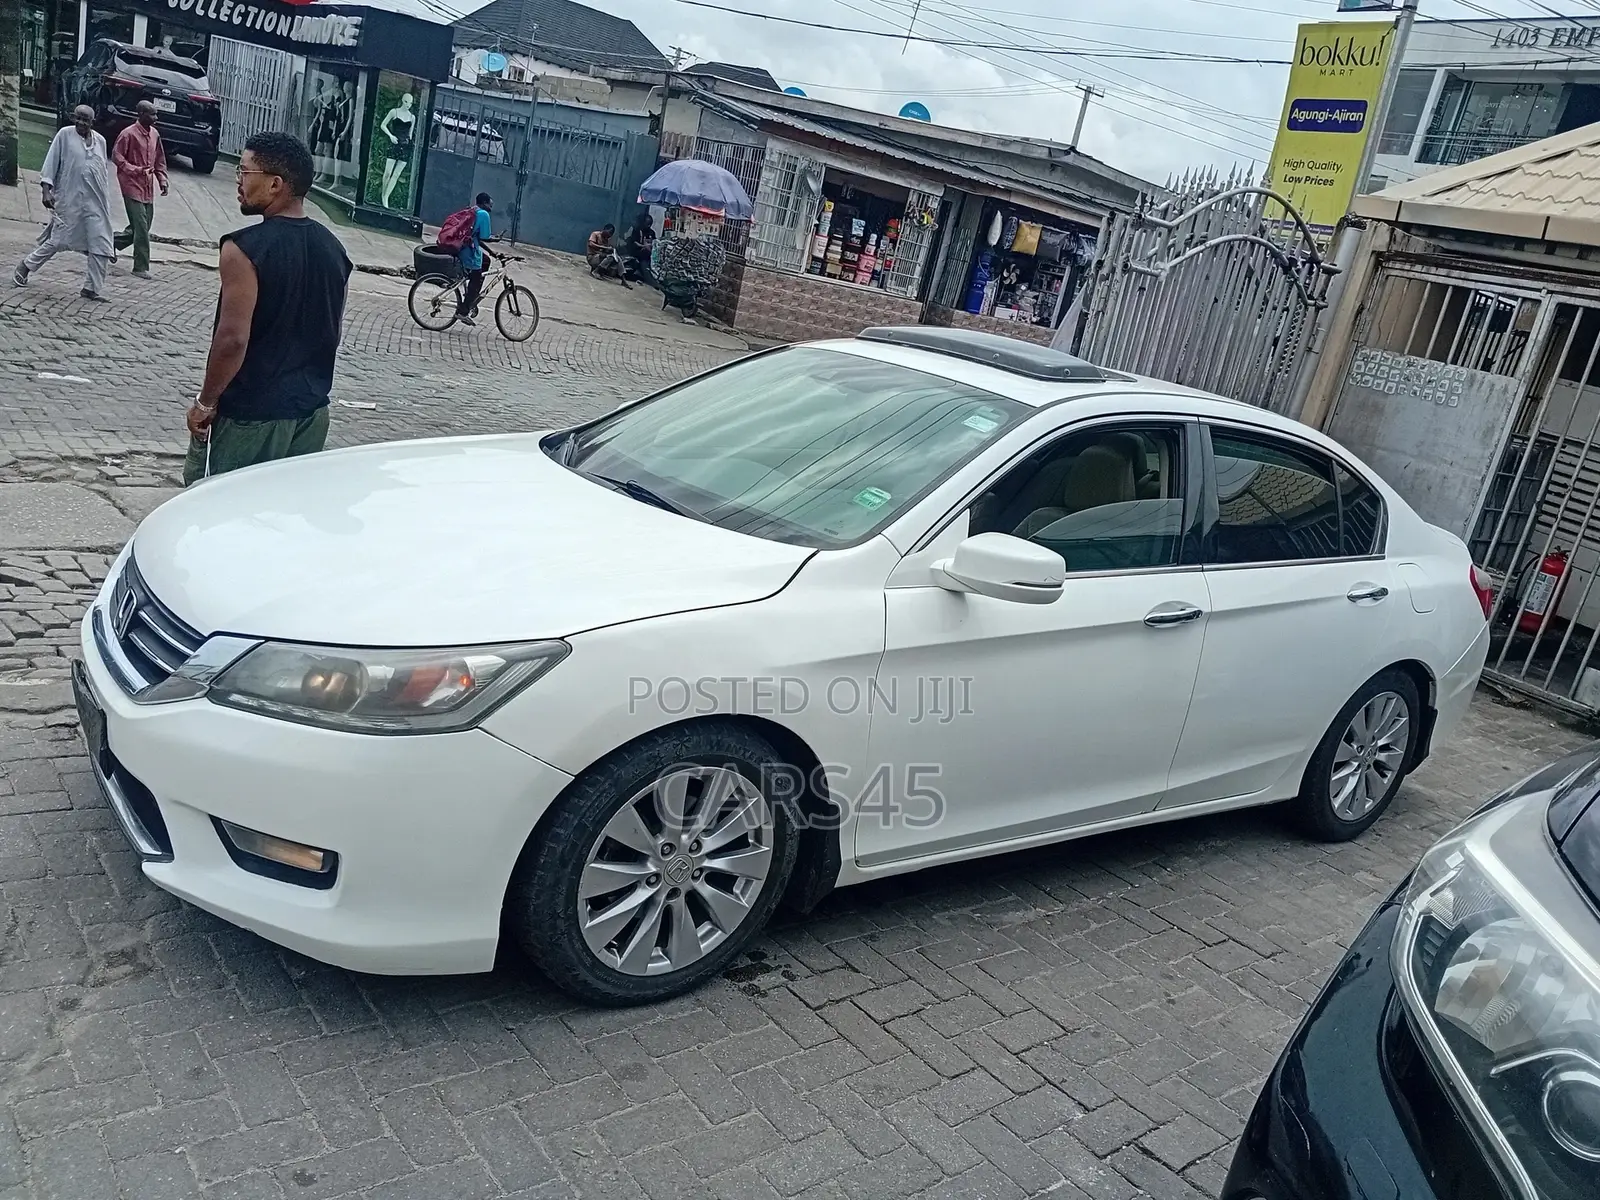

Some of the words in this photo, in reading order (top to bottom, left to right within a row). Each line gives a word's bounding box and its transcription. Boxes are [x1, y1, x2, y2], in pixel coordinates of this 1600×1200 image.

[1490, 27, 1540, 49] 1403
[1299, 36, 1385, 66] bokku!
[1319, 69, 1354, 77] MART
[1291, 107, 1364, 124] Agungi-Ajiran
[1283, 158, 1305, 171] High
[1307, 160, 1344, 174] Quality,
[1283, 174, 1303, 184] Low
[1304, 175, 1335, 187] Prices
